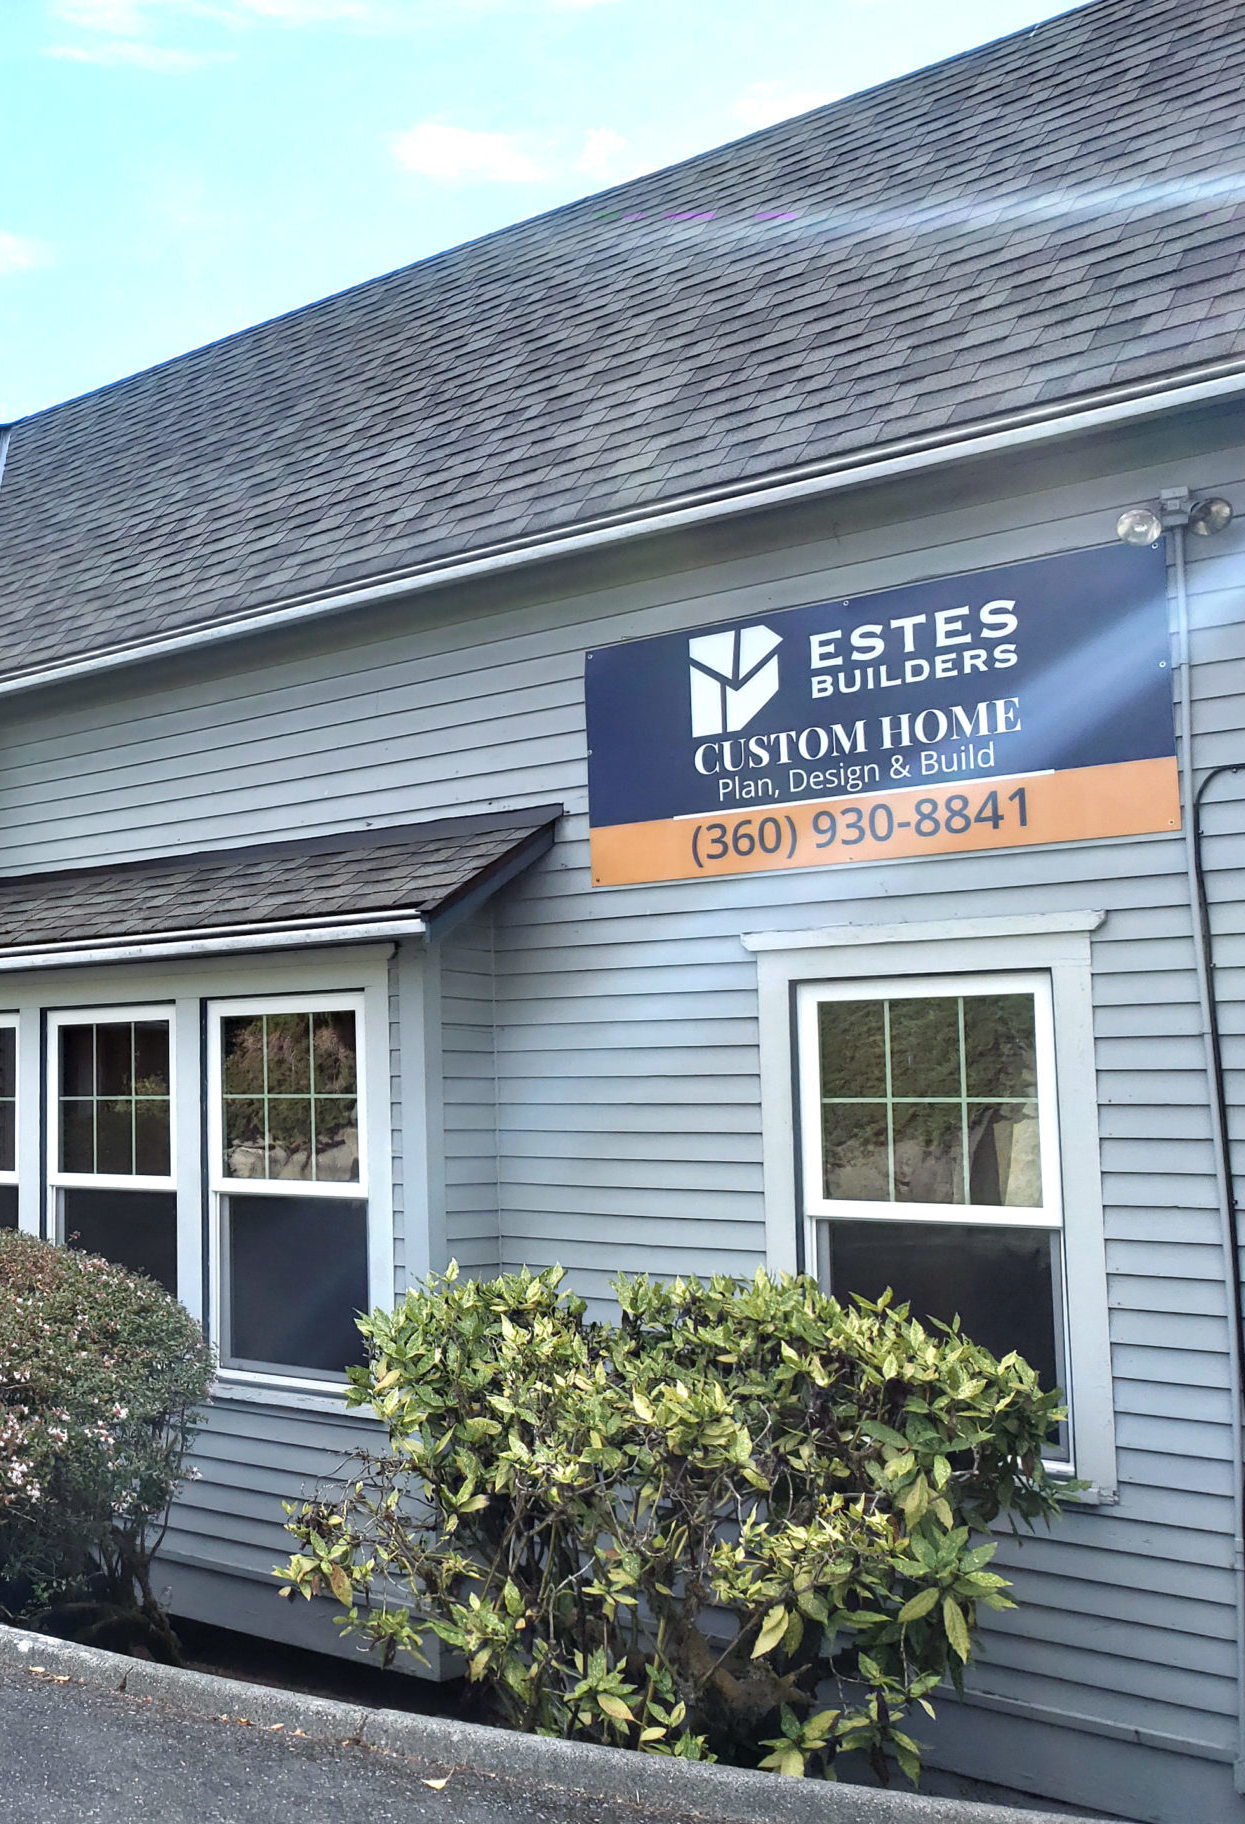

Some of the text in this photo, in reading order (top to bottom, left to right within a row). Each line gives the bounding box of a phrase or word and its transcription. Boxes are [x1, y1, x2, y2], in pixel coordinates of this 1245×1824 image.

[809, 600, 1019, 670] ESTES
[812, 643, 1019, 699] BUILDERS
[694, 697, 1022, 776] CUSTOM HOME
[718, 742, 996, 802] Plan, Design & Build
[691, 787, 1029, 868] (360) 930-8841
